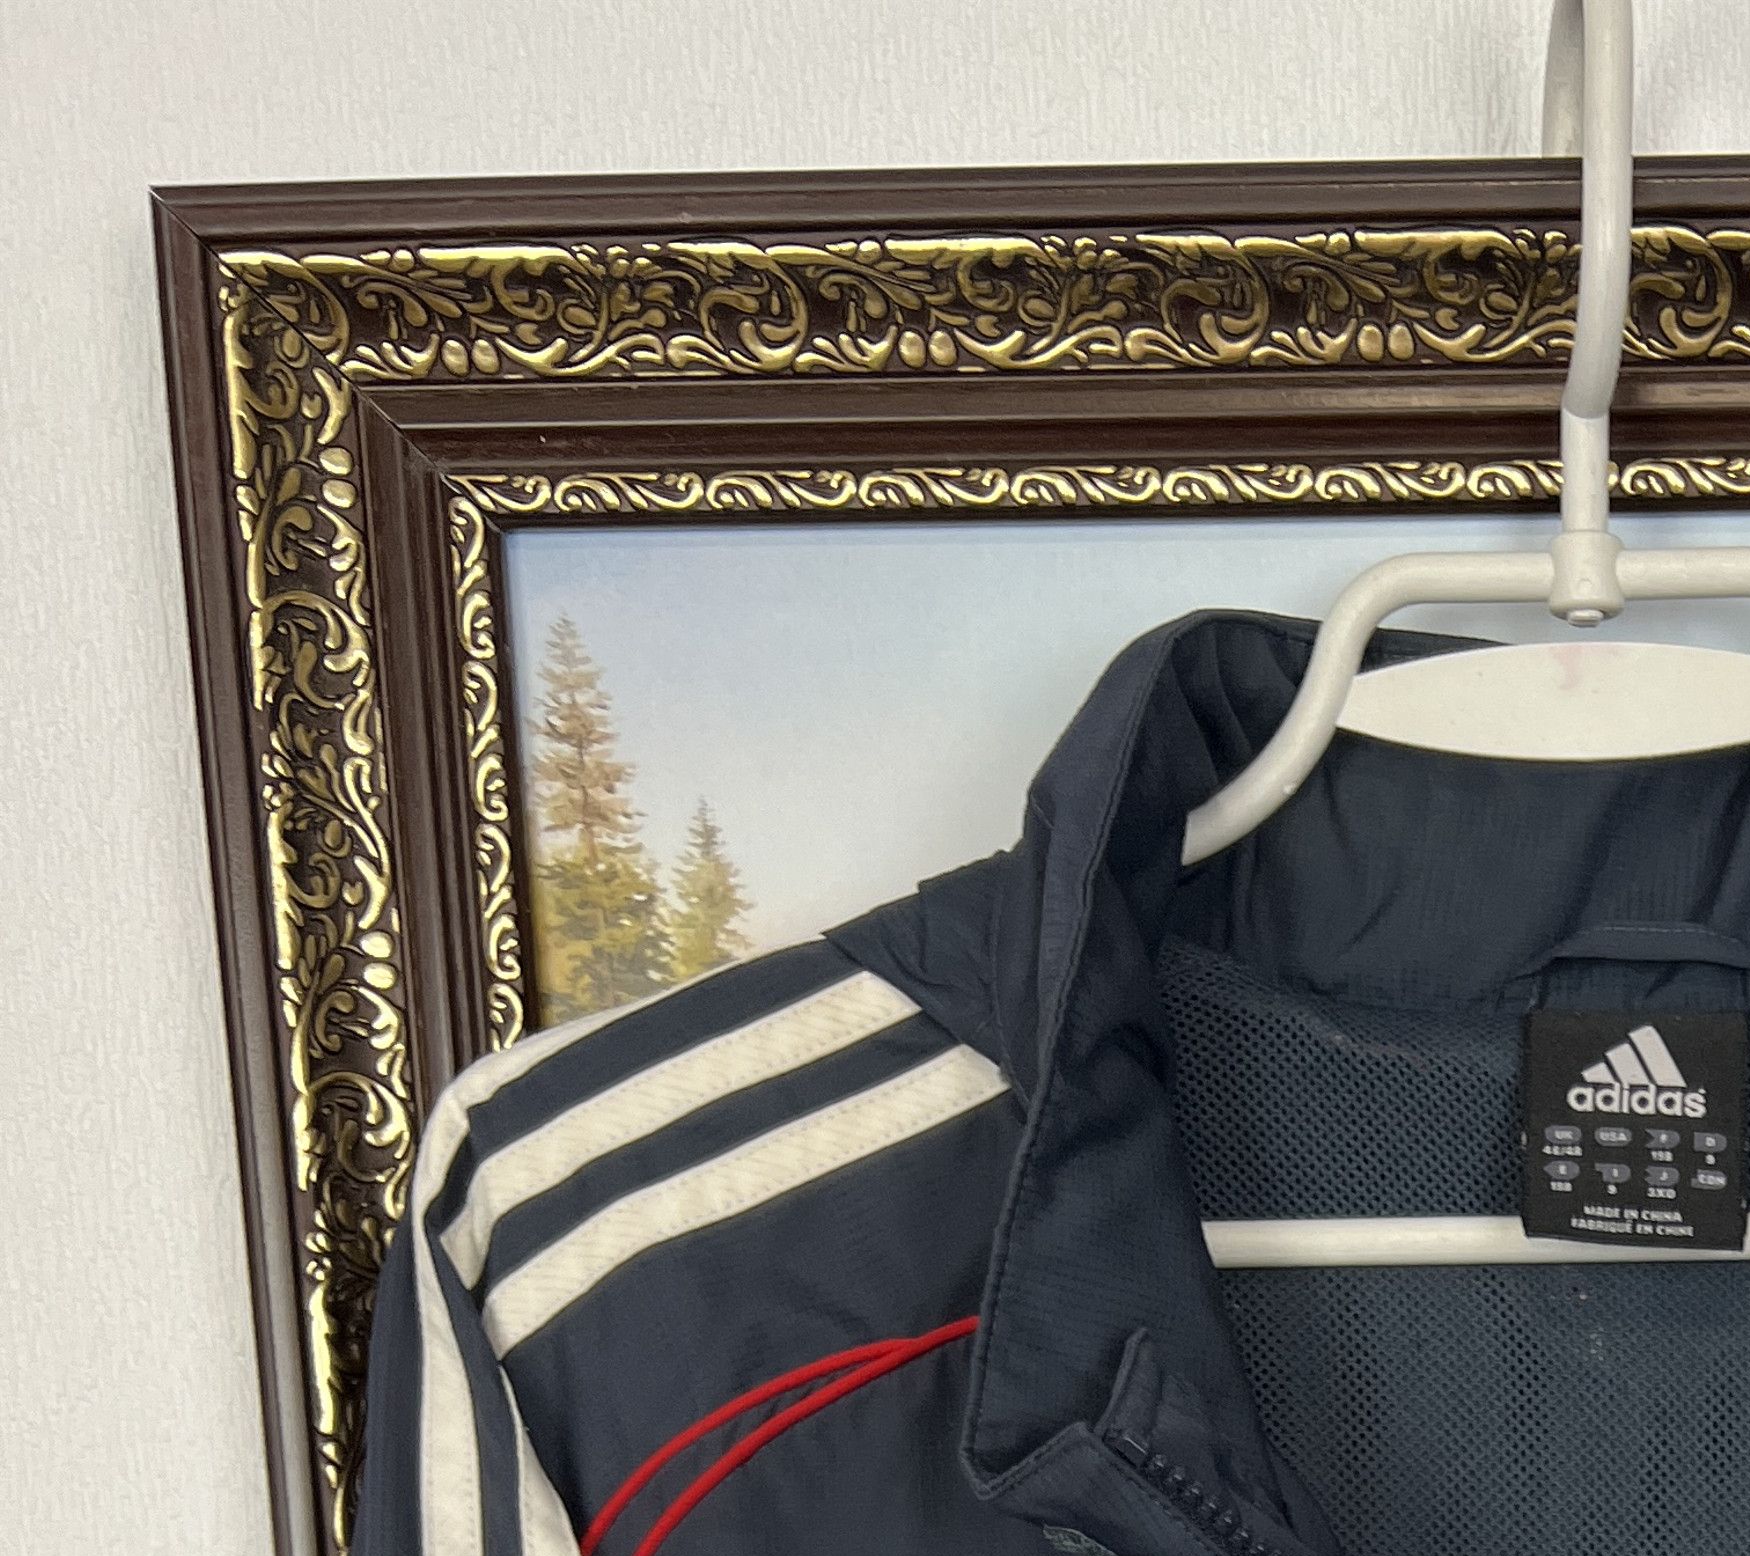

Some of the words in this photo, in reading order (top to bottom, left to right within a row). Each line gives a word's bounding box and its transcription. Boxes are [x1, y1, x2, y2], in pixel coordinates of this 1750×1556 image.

[1566, 1082, 1707, 1118] adidas
[1600, 1131, 1628, 1141] USA
[1583, 1205, 1620, 1219] MADE
[1623, 1208, 1639, 1220] IN
[1641, 1209, 1683, 1223] CHINA
[1635, 1222, 1653, 1235] EN
[1655, 1225, 1694, 1237] CHINE
